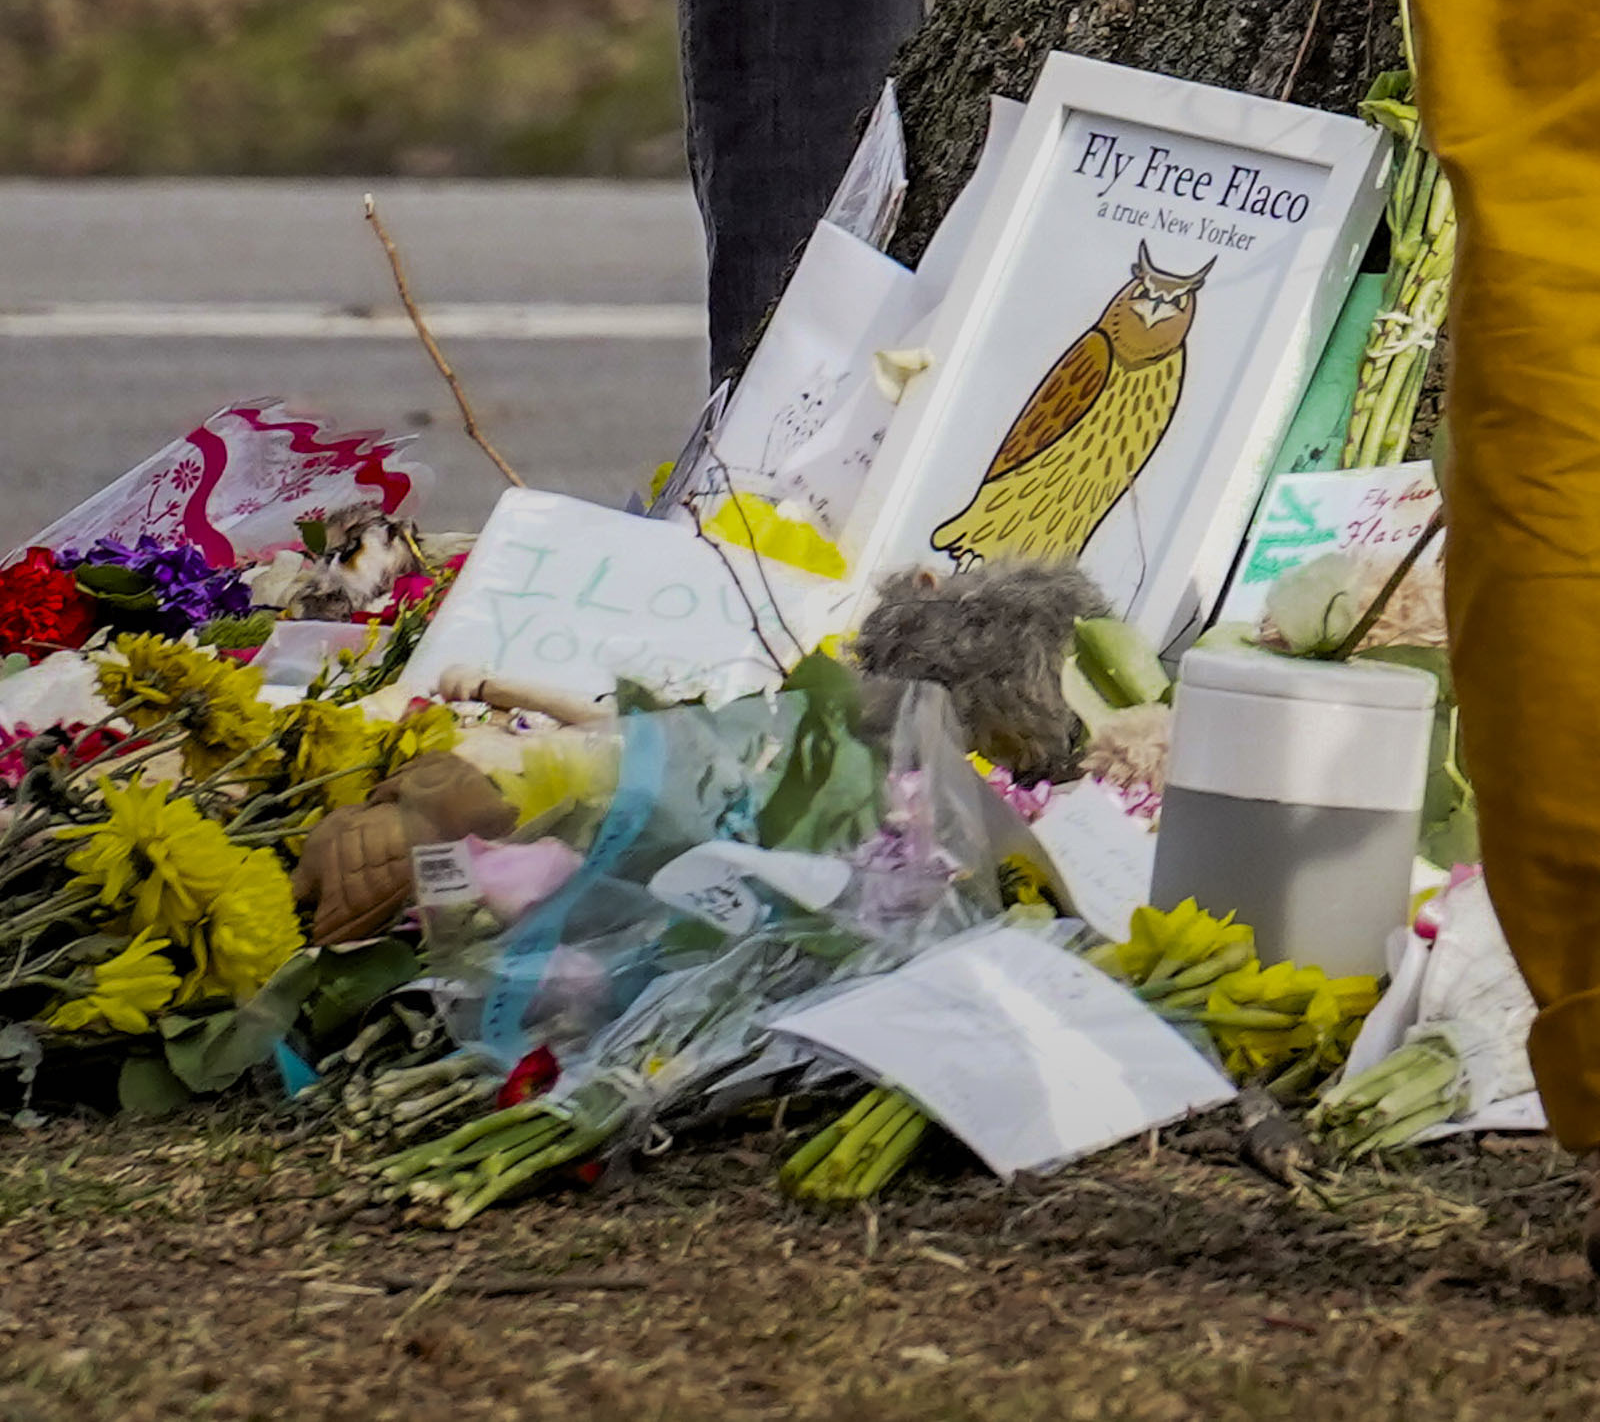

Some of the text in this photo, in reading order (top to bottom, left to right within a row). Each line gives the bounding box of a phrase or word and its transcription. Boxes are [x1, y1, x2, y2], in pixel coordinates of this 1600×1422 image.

[1073, 131, 1310, 224] Fly Free Flaco
[1097, 200, 1256, 251] a true New Yorker
[483, 540, 558, 600] I
